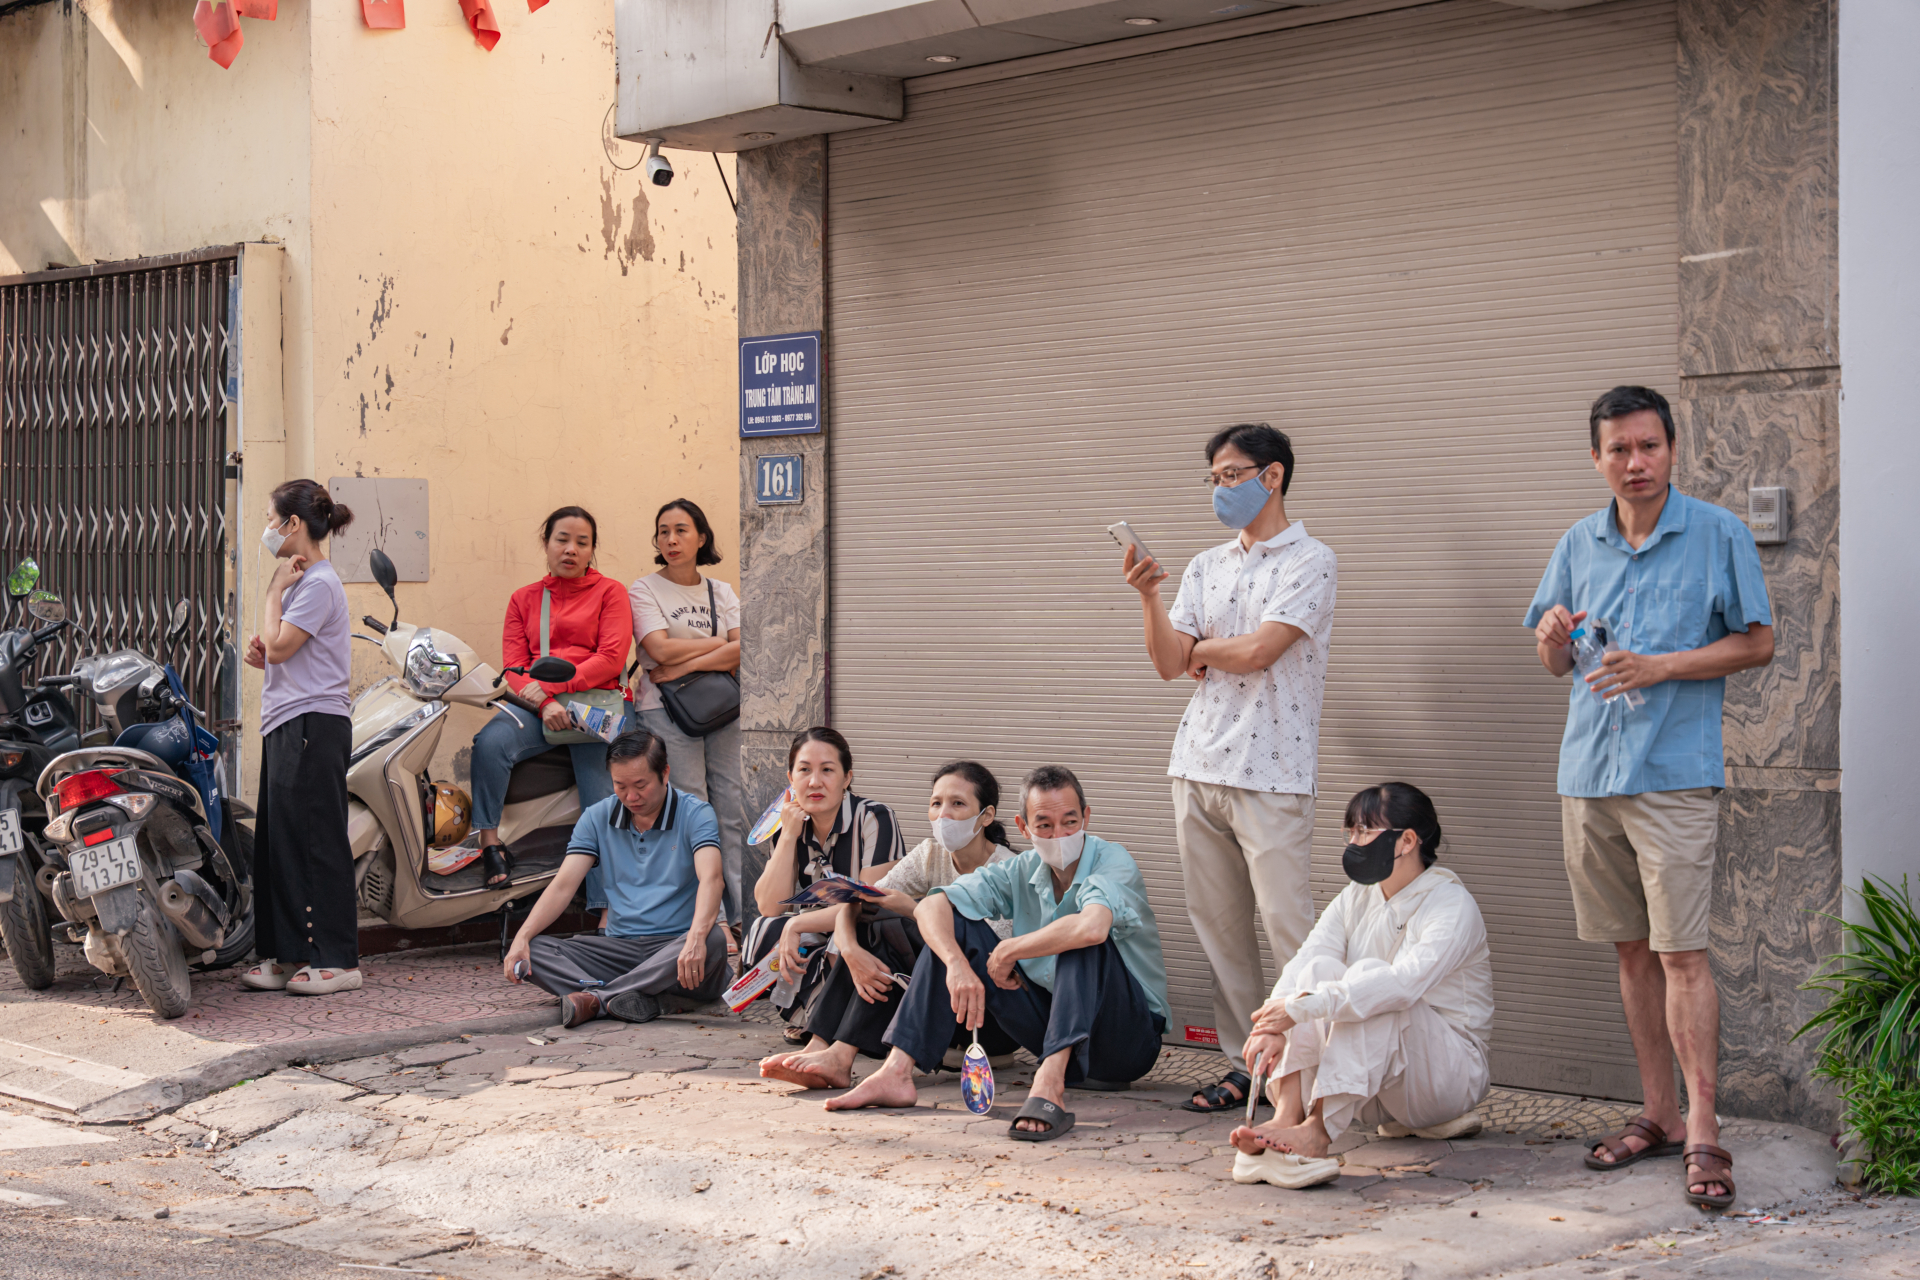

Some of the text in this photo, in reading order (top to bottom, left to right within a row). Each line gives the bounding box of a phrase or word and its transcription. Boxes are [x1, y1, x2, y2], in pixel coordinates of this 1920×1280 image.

[755, 350, 805, 376] LỚP HỌC
[745, 381, 815, 409] TRUNG TÂM TRÀNG AN
[762, 461, 794, 497] 161
[688, 619, 712, 629] ALOHA
[79, 840, 127, 872] 29-L1
[80, 860, 137, 894] 413.76
